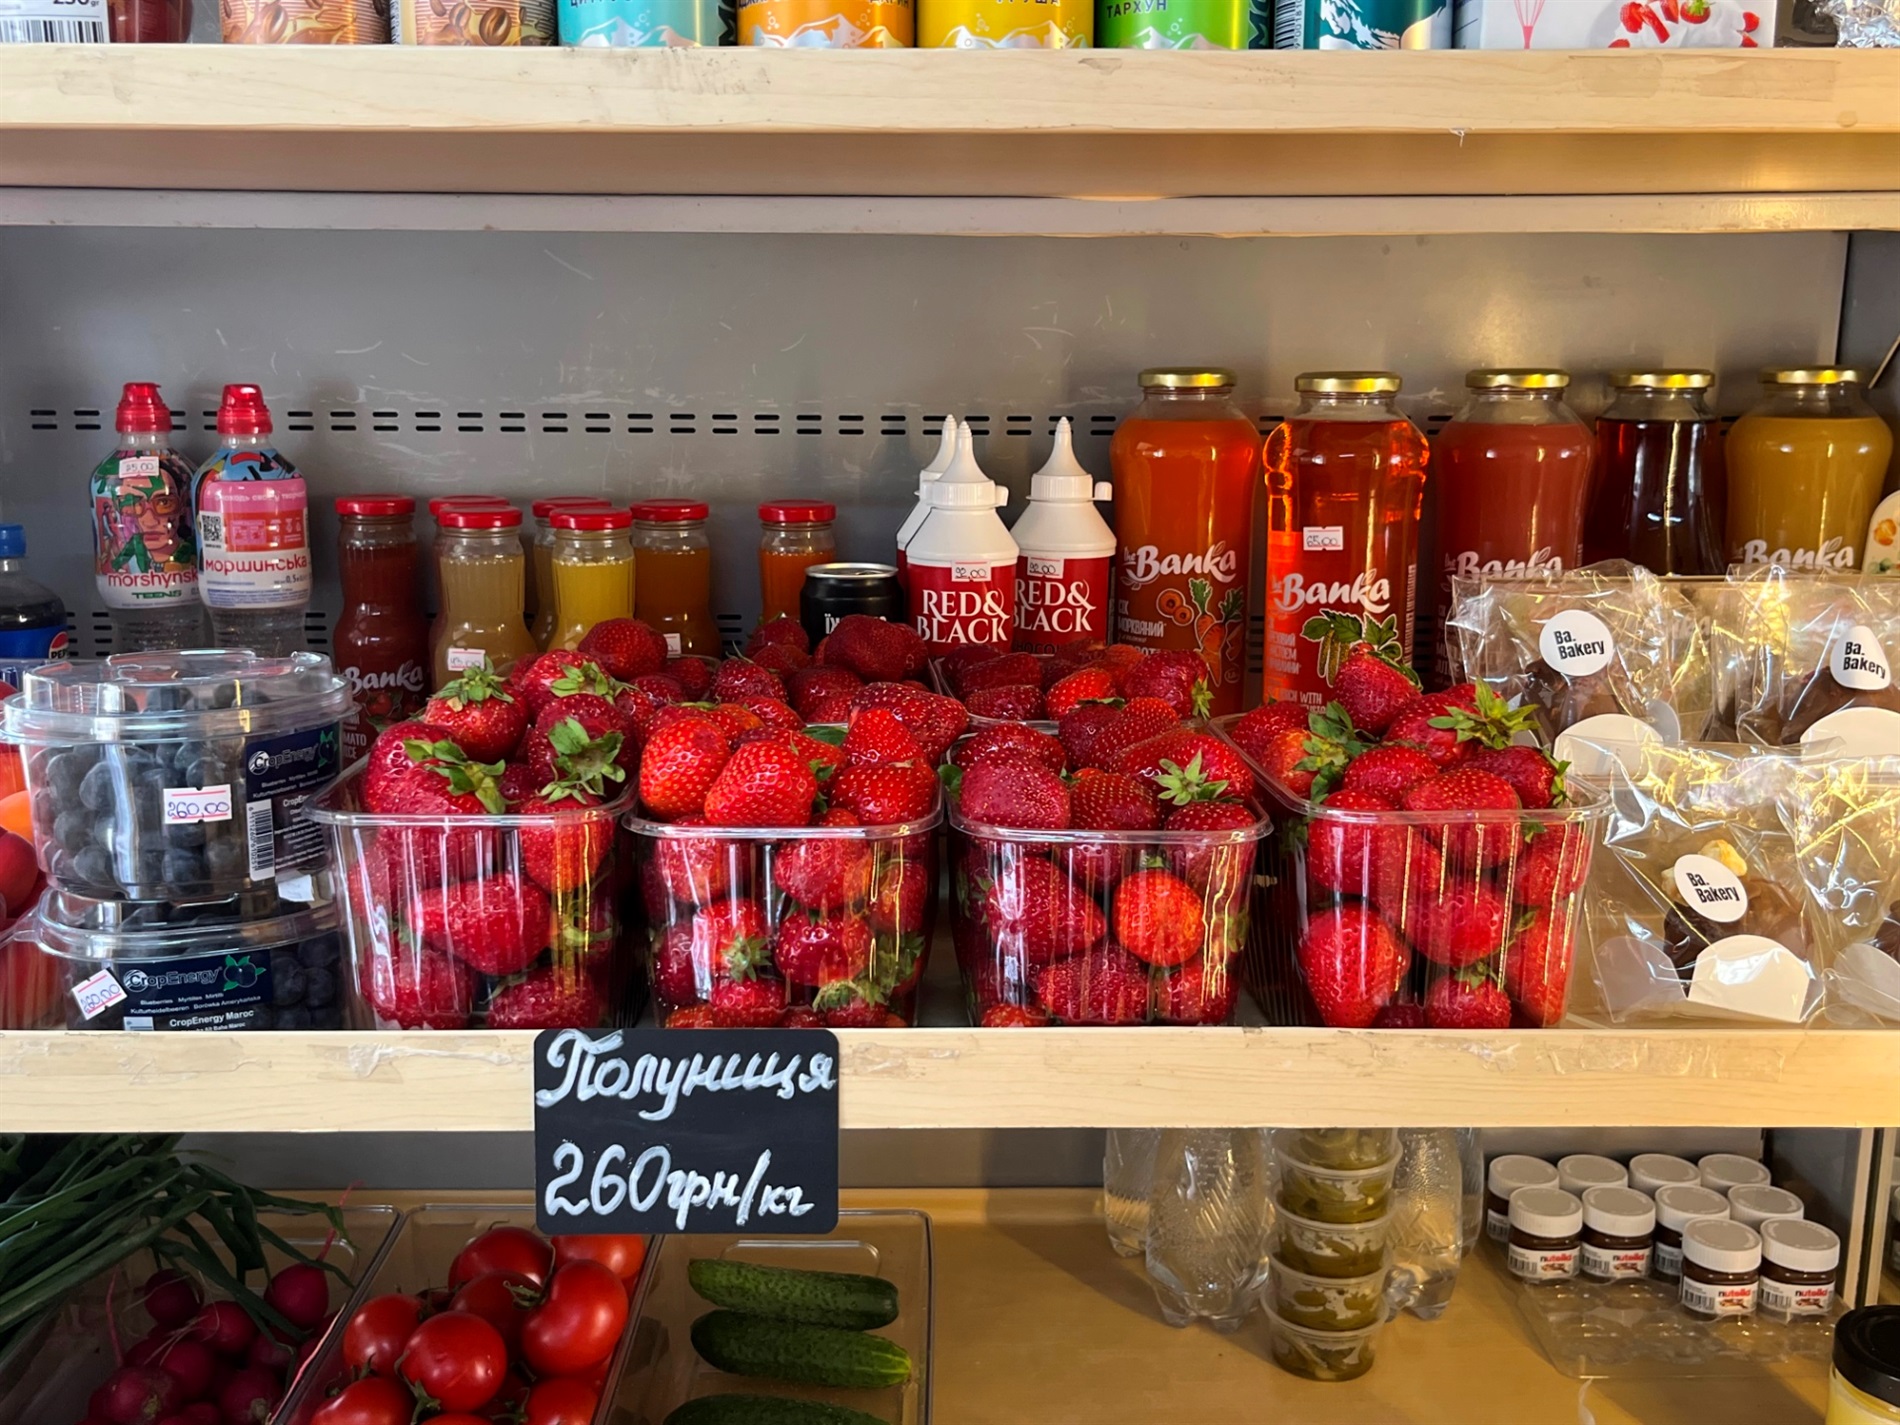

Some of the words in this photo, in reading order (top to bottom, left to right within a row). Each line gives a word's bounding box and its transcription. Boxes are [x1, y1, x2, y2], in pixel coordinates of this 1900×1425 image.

[1107, 0, 1167, 18] ТАРХУН
[1127, 545, 1237, 583] Banka
[1274, 573, 1390, 614] Banka
[923, 587, 1010, 622] RED&
[917, 616, 1008, 644] BLACK
[1553, 630, 1576, 645] Ba.
[1558, 640, 1605, 660] Bakery
[1845, 641, 1865, 656] Ba.
[1843, 656, 1886, 680] Bakery
[168, 802, 230, 819] 260,00
[1686, 872, 1710, 887] Ba.
[1695, 886, 1740, 904] Bakery
[130, 968, 219, 989] CropEnergy
[169, 1014, 224, 1028] CropEnergy
[225, 1009, 254, 1021] Maroc
[535, 1028, 837, 1120] Полуниця
